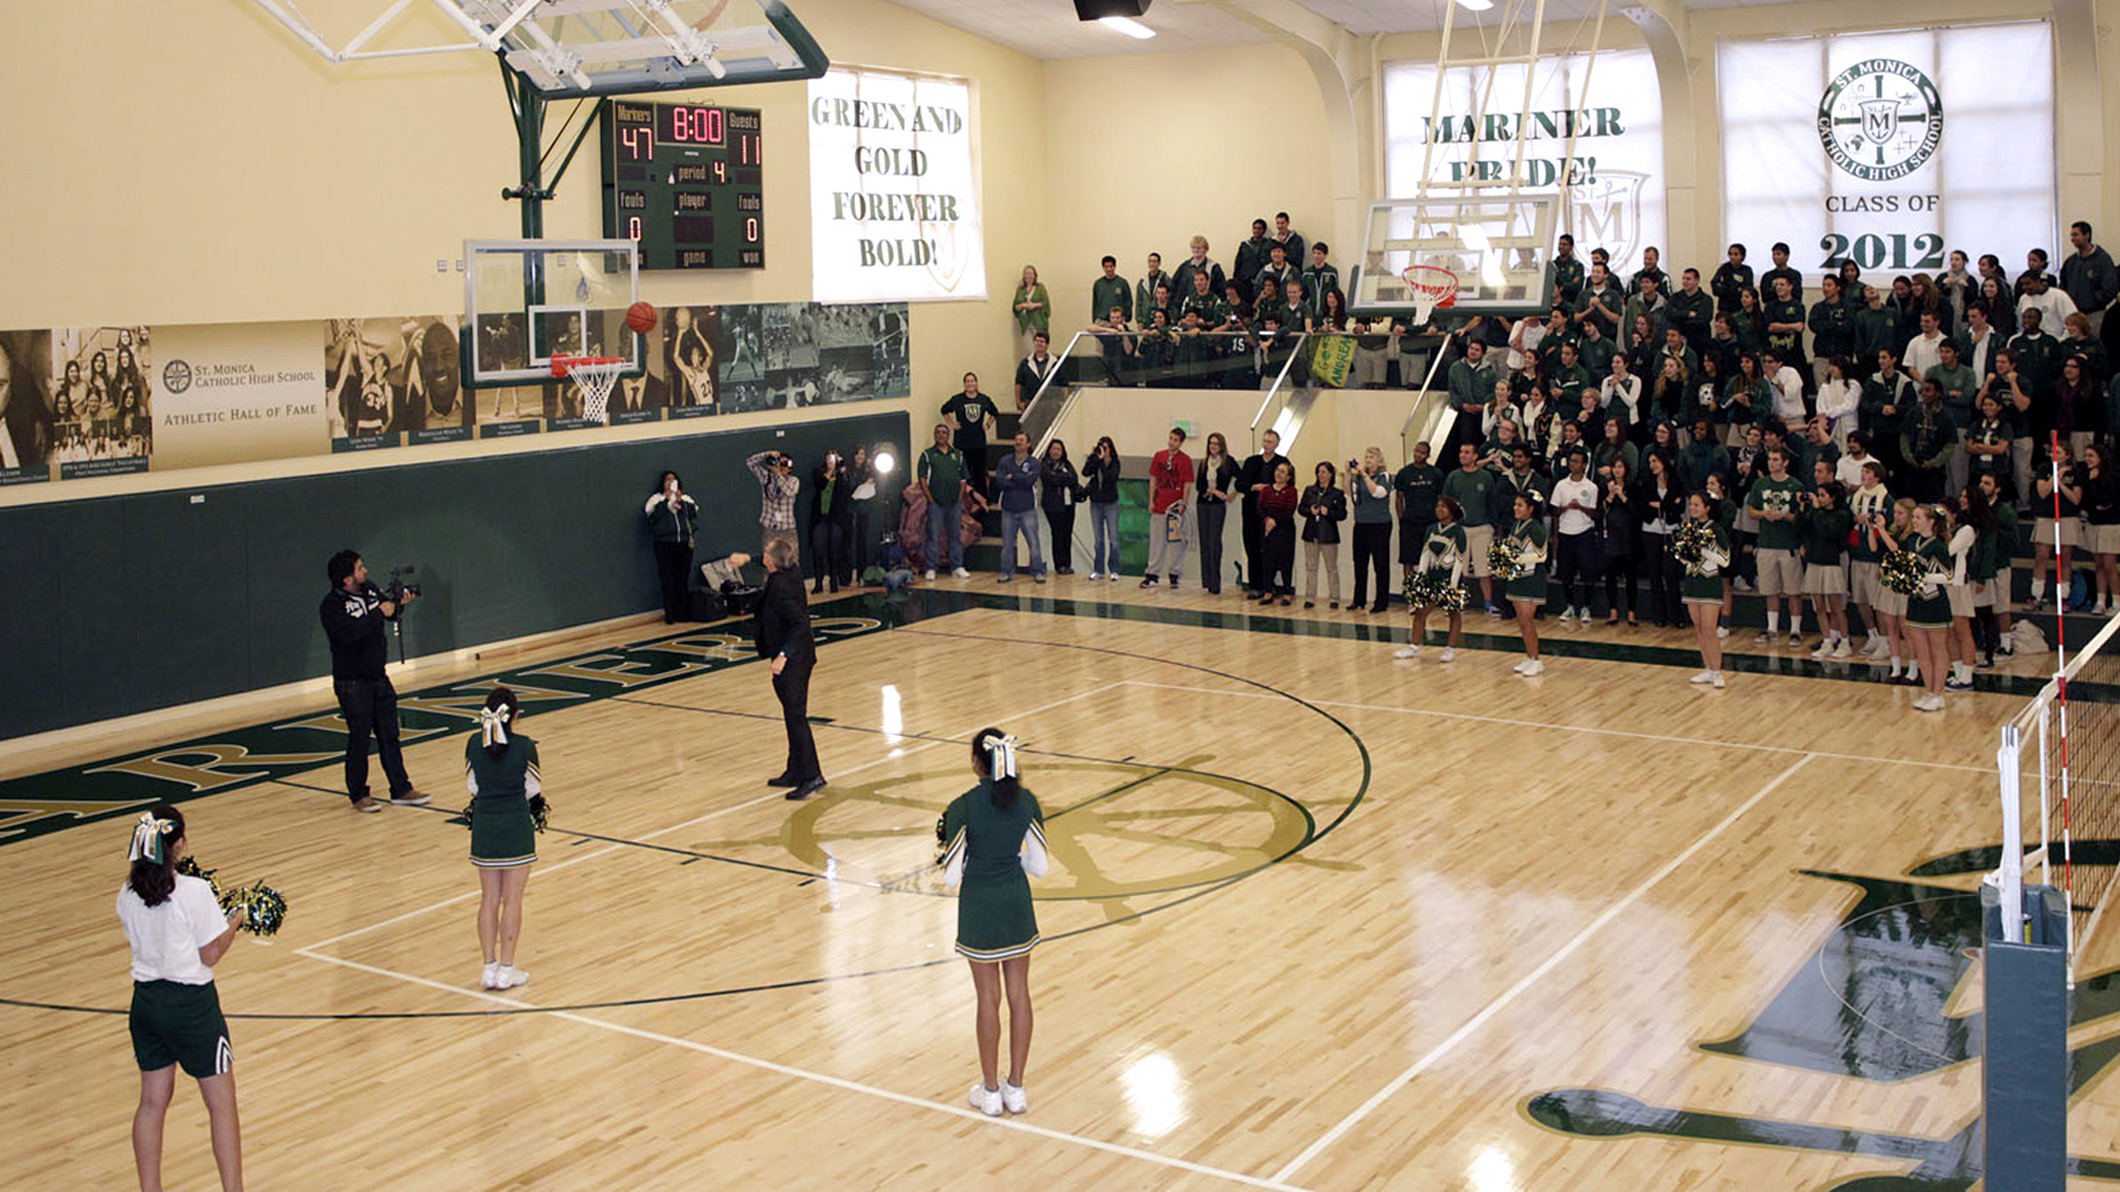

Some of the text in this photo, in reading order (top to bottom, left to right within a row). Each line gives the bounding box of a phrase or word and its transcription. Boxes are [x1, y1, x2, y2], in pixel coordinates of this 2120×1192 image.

[1835, 60, 1921, 89] ST. MONICA
[617, 105, 652, 122] Mariners
[673, 107, 722, 142] 8:00
[729, 112, 759, 129] Guests
[812, 97, 962, 135] GREEN AND
[1870, 113, 1889, 131] M
[1421, 107, 1625, 145] MARINER
[623, 128, 653, 160] 47
[742, 135, 760, 165] 11
[1819, 111, 1942, 180] CATHOLIC HIGH SCHOOL
[678, 165, 706, 182] period
[714, 161, 725, 183] 4
[855, 146, 928, 177] GOLD
[1449, 156, 1597, 188] PRIDE!
[620, 192, 645, 208] fouls
[679, 193, 707, 210] player
[738, 195, 760, 209] fouls
[832, 192, 960, 222] FOREVER
[1825, 194, 1940, 212] CLASS OF
[629, 216, 642, 242] 0
[747, 218, 758, 242] 0
[1575, 202, 1627, 244] M
[683, 251, 712, 267] game
[742, 252, 760, 264] won
[858, 238, 938, 268] BOLD!
[1819, 233, 1945, 270] 2012
[195, 371, 316, 388] CATHOLIC HIGH SCHOOL
[213, 364, 255, 376] MONICA
[164, 411, 226, 426] ATHLETIC
[230, 408, 262, 421] HALL
[286, 404, 318, 416] FAME
